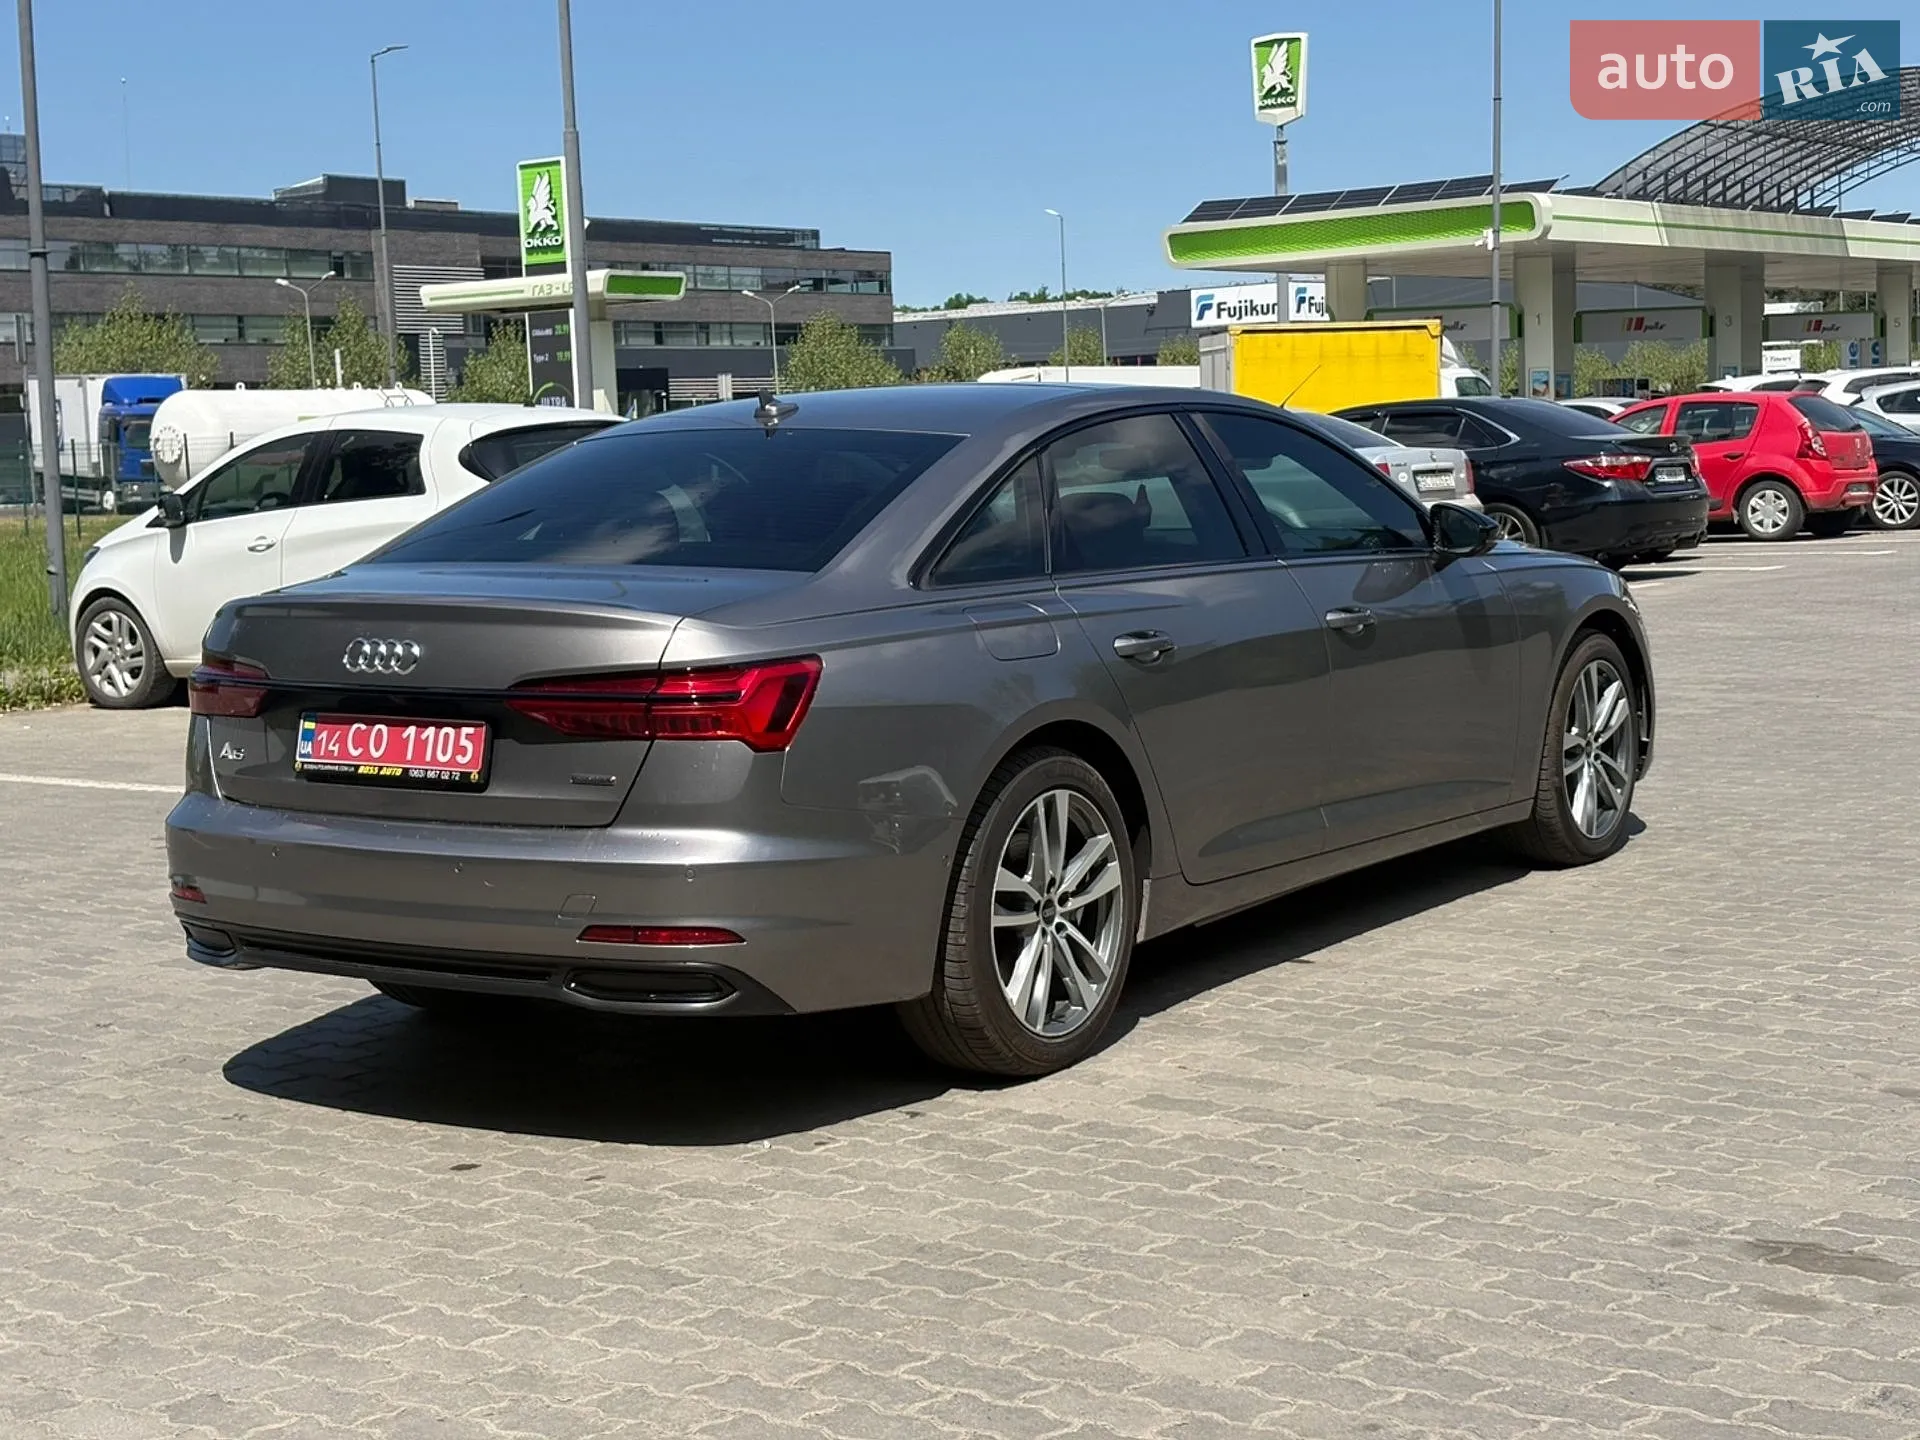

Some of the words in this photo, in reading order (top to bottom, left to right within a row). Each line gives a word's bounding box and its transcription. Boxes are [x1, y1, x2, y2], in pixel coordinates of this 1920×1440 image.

[1258, 96, 1296, 107] OKKO
[524, 236, 562, 248] OKKO
[300, 740, 313, 755] UA
[316, 729, 342, 757] 14
[346, 722, 389, 759] CO
[401, 725, 475, 765] 1105
[357, 765, 379, 775] BOSS
[379, 767, 404, 777] AUTO
